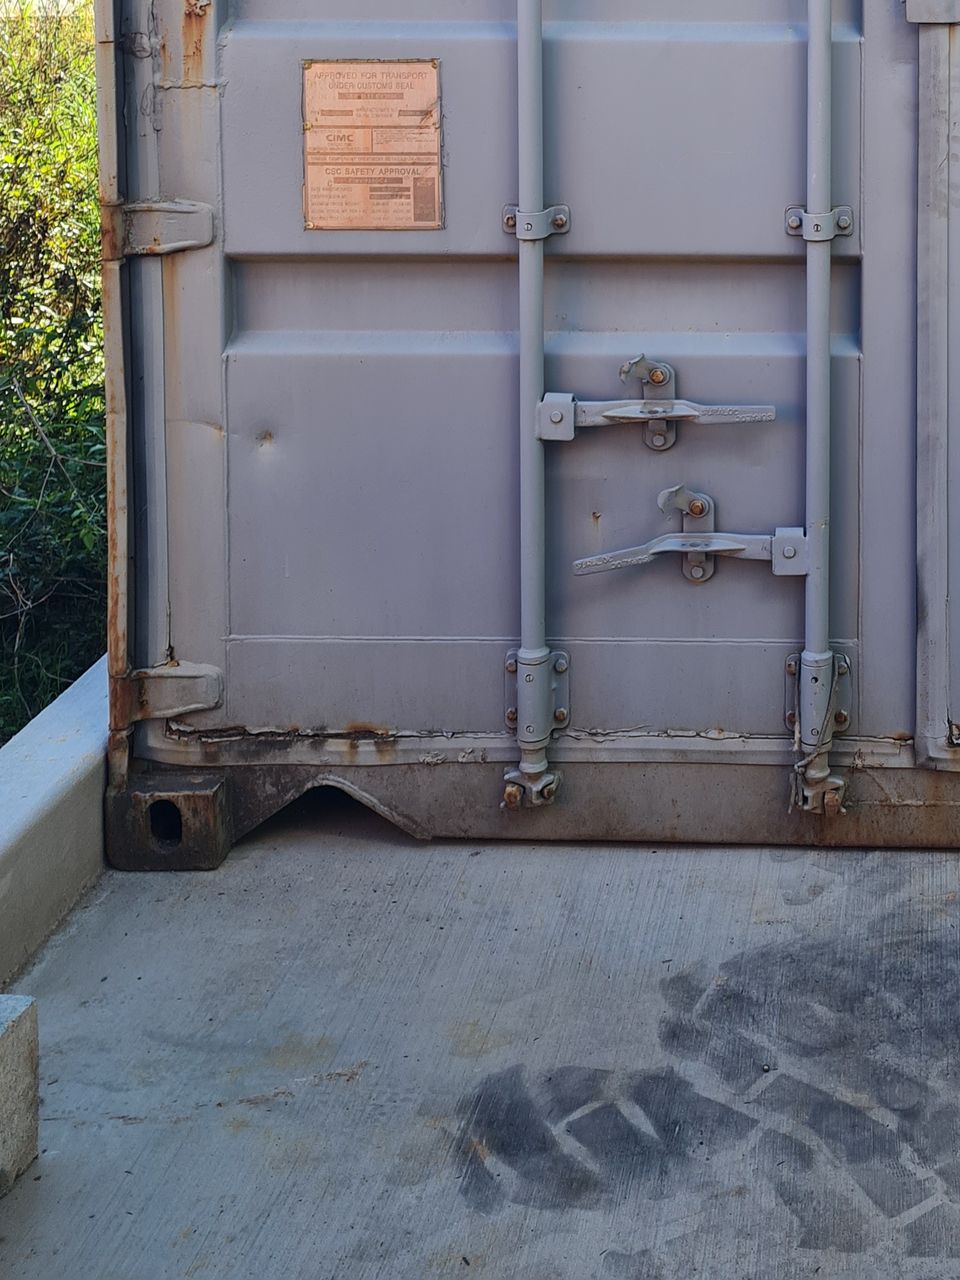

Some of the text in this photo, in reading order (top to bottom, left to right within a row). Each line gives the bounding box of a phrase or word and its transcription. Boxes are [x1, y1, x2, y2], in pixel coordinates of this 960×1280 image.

[313, 71, 428, 80] APPROVED FOR TRANSPORT
[328, 81, 415, 90] UNDER CUSTOMS SEAL
[325, 134, 354, 142] CIMC
[325, 167, 420, 176] CSC SAFETY APPROVAL
